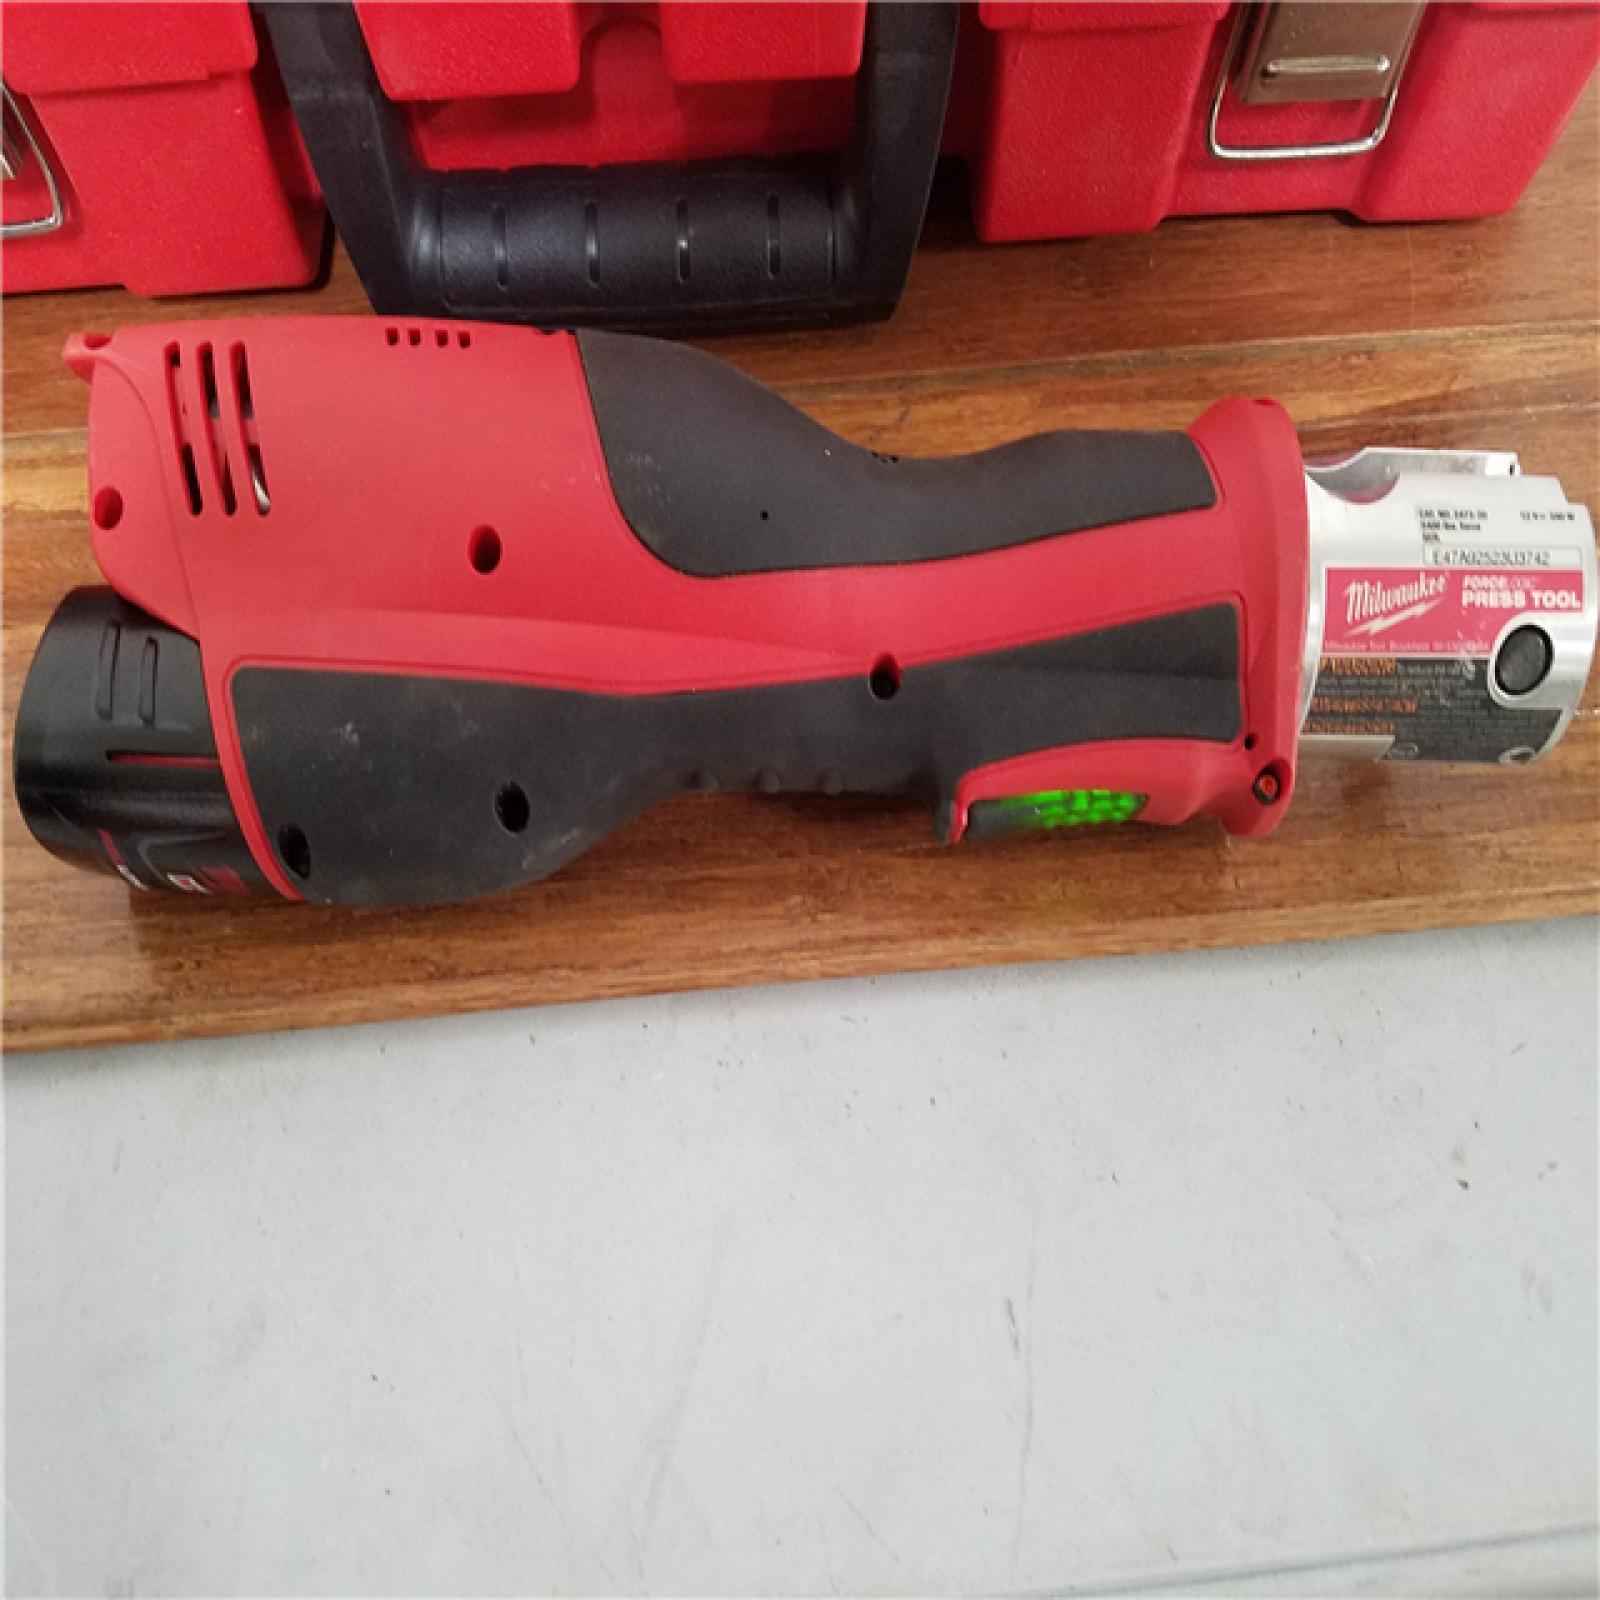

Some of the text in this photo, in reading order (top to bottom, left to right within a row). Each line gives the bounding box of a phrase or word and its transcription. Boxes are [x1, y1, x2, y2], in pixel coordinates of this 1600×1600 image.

[1343, 571, 1446, 625] Milwaukee
[1462, 589, 1581, 608] PRESS TOOL
